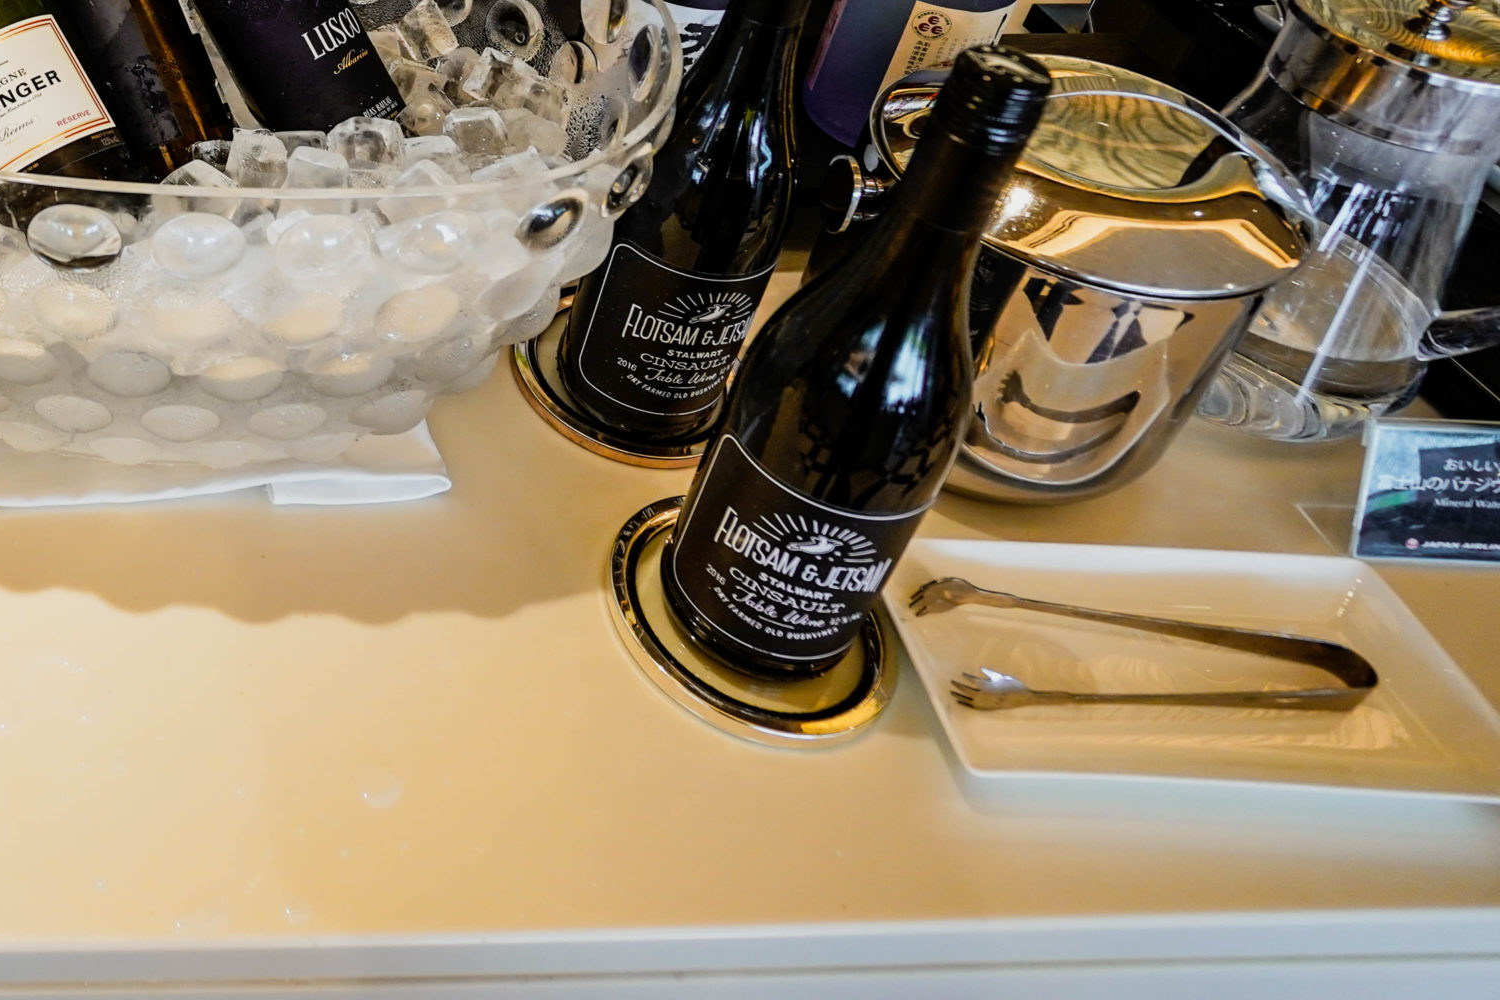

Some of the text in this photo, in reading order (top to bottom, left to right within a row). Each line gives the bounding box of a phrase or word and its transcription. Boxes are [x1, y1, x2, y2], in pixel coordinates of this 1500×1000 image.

[301, 7, 361, 61] LUSCO
[56, 109, 93, 127] RÉSERVE
[622, 303, 700, 346] FLOTSAM
[701, 330, 713, 346] &
[616, 356, 638, 372] 2016
[640, 352, 731, 371] CINSAULT
[666, 349, 723, 359] STALWART
[626, 374, 642, 386] DRY
[641, 383, 672, 398] FARMED
[644, 366, 717, 385] Table Wine
[713, 506, 801, 577] FLOTSAM
[801, 564, 819, 582] &
[705, 563, 846, 614] 2016 CINSAULT
[758, 571, 833, 601] STALWART
[713, 586, 729, 604] DRY
[727, 604, 763, 630] FARMED
[764, 627, 784, 638] OLD
[731, 585, 779, 618] Table
[782, 609, 826, 628] Wine
